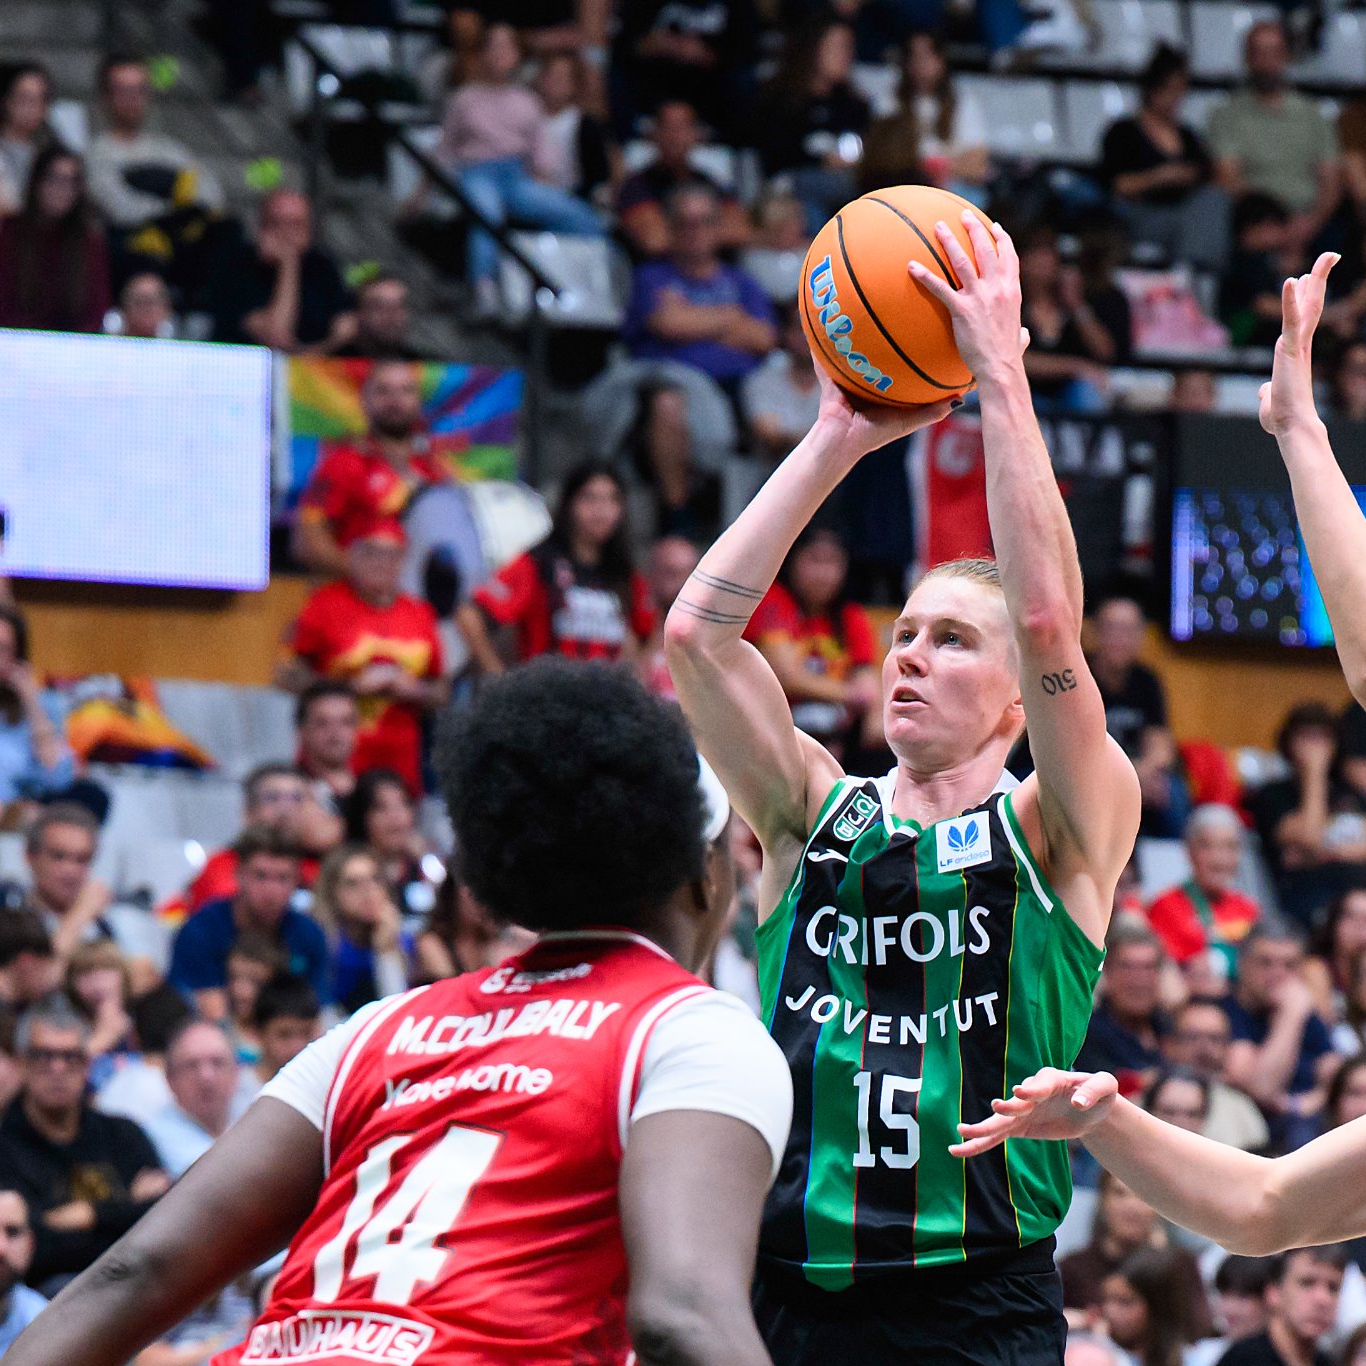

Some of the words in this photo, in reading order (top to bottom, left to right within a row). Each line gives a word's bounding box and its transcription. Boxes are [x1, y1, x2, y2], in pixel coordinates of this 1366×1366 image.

[808, 253, 894, 393] Wilson
[939, 858, 954, 868] LF
[805, 904, 992, 967] GRIFOLS
[785, 985, 1000, 1046] JOVENTUT
[851, 1070, 923, 1170] 15
[311, 1123, 503, 1308] 14
